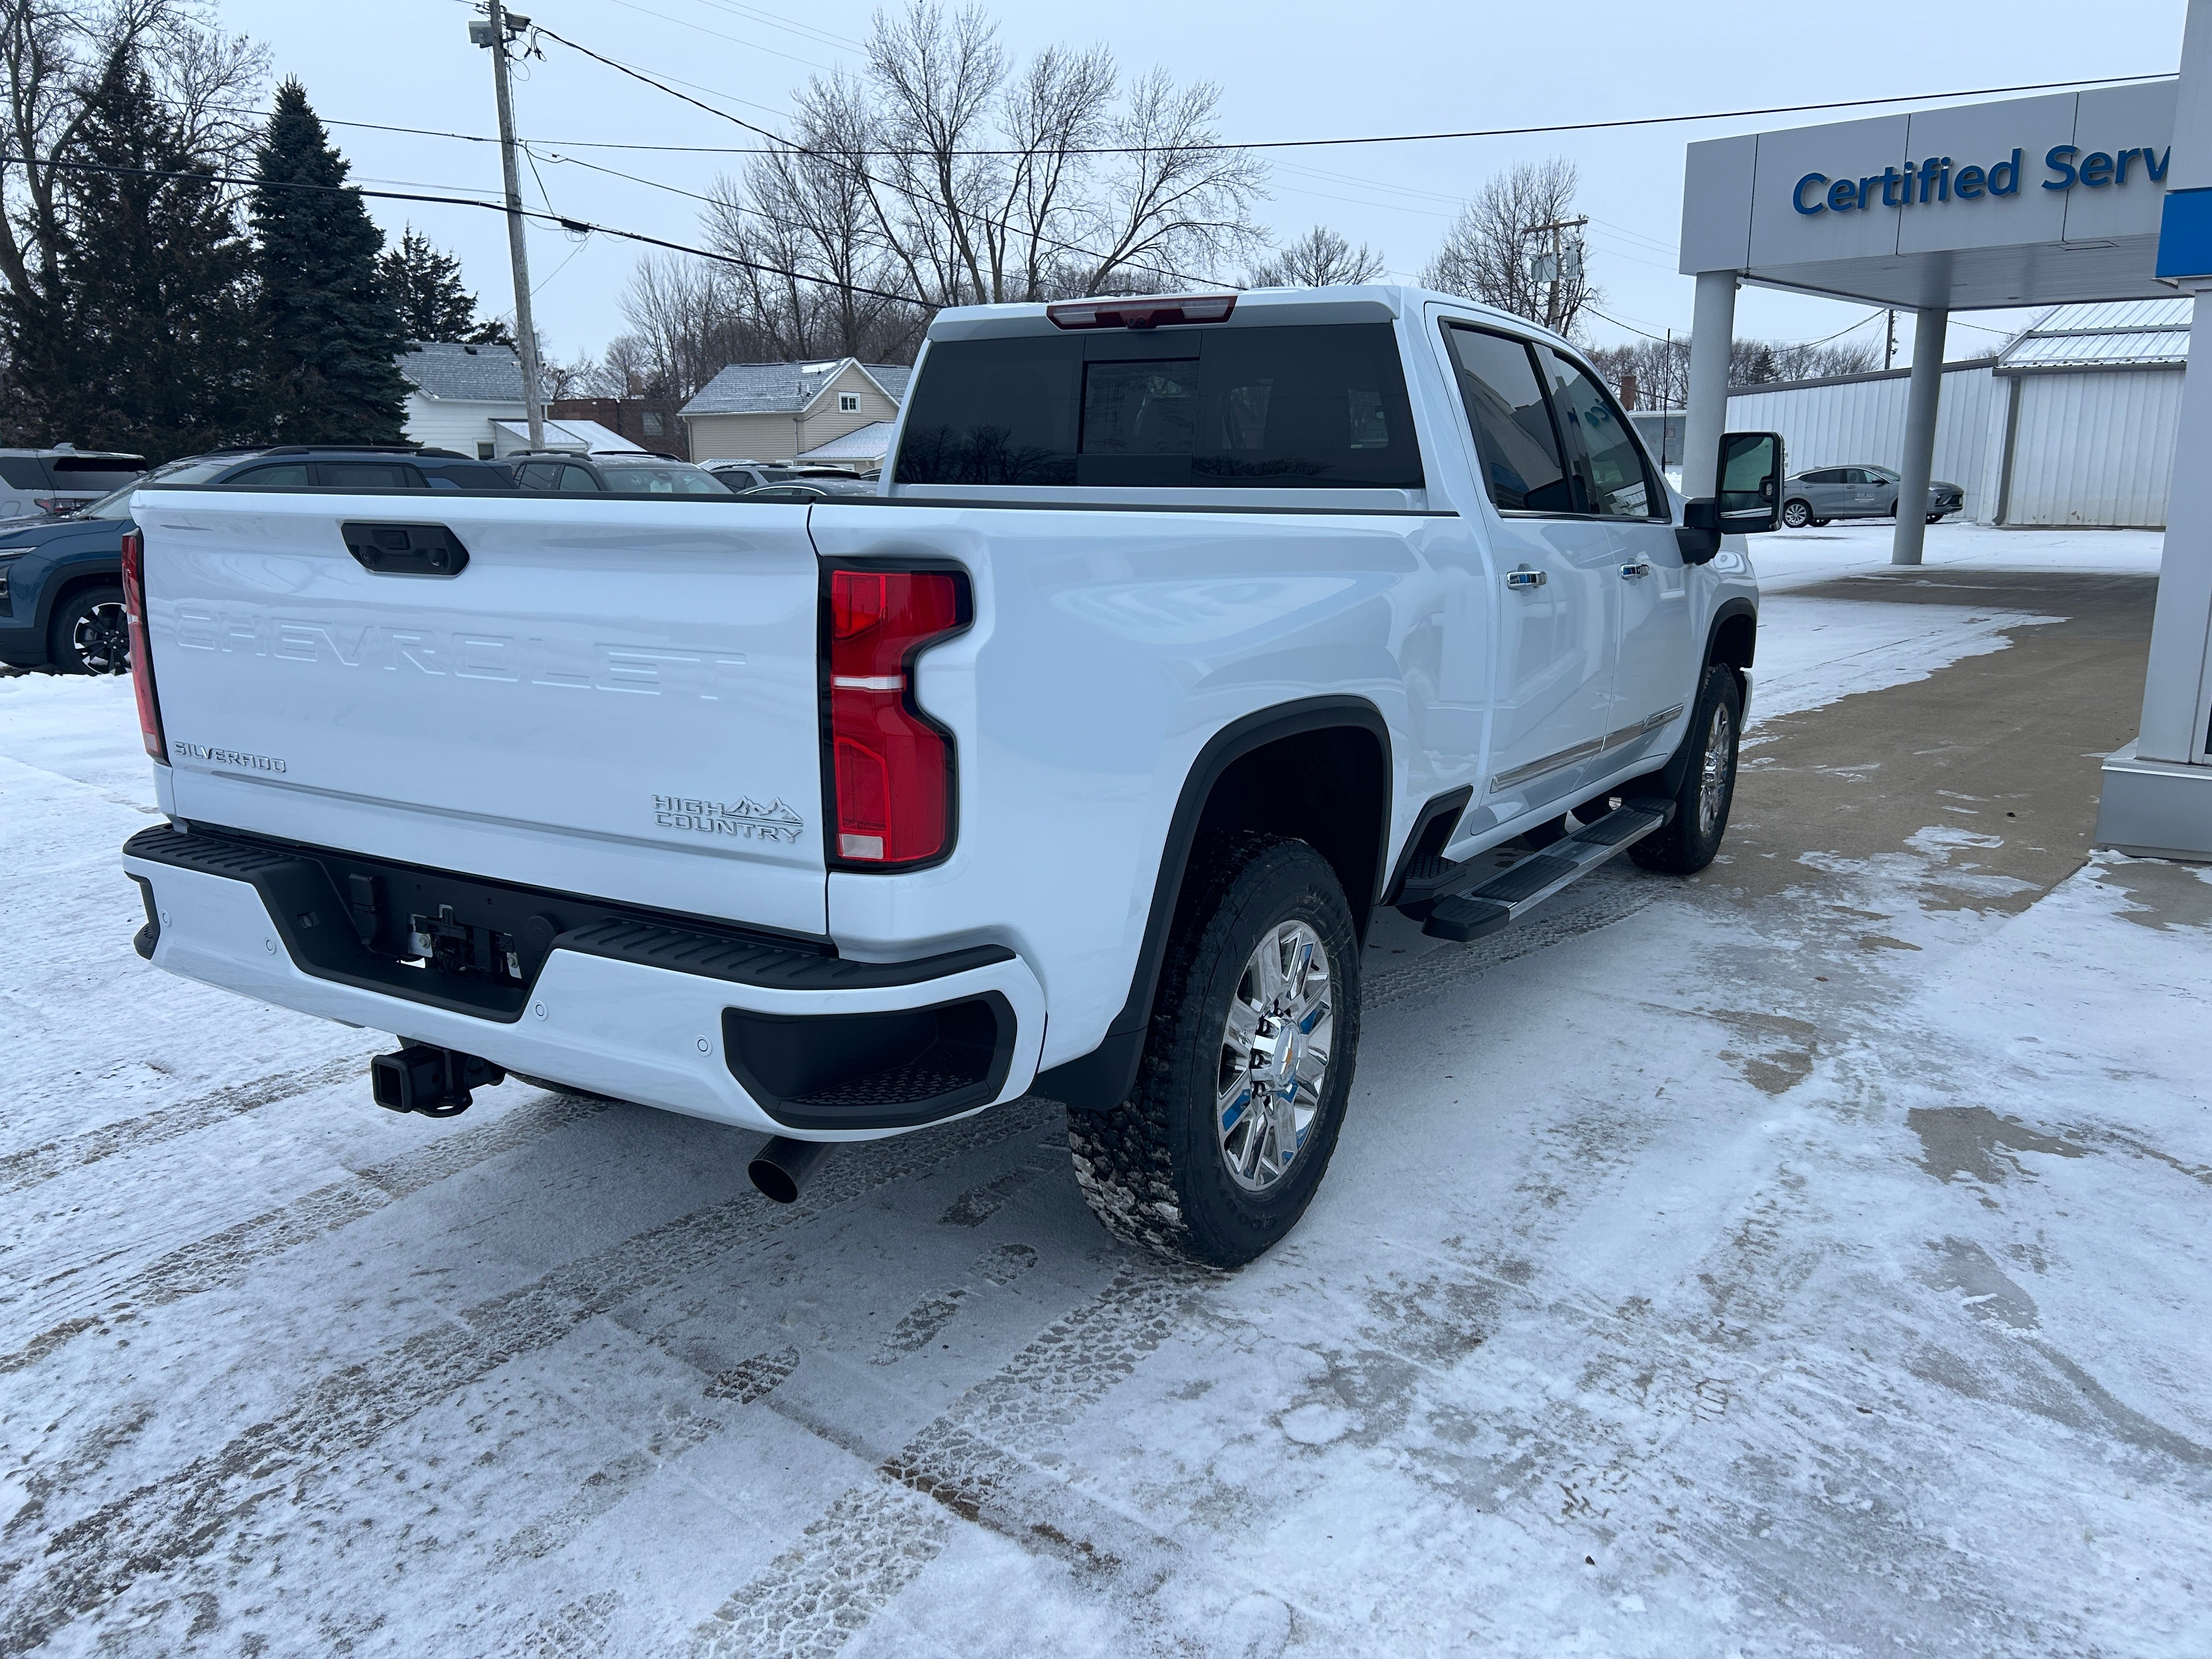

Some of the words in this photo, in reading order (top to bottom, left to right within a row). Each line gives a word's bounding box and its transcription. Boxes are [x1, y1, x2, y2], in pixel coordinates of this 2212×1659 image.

[1792, 148, 2024, 216] Certified
[174, 606, 747, 701] CHEVROLET
[173, 741, 287, 773] SILVERADO
[652, 794, 725, 817] HIGH
[653, 811, 803, 843] COUNTRY
